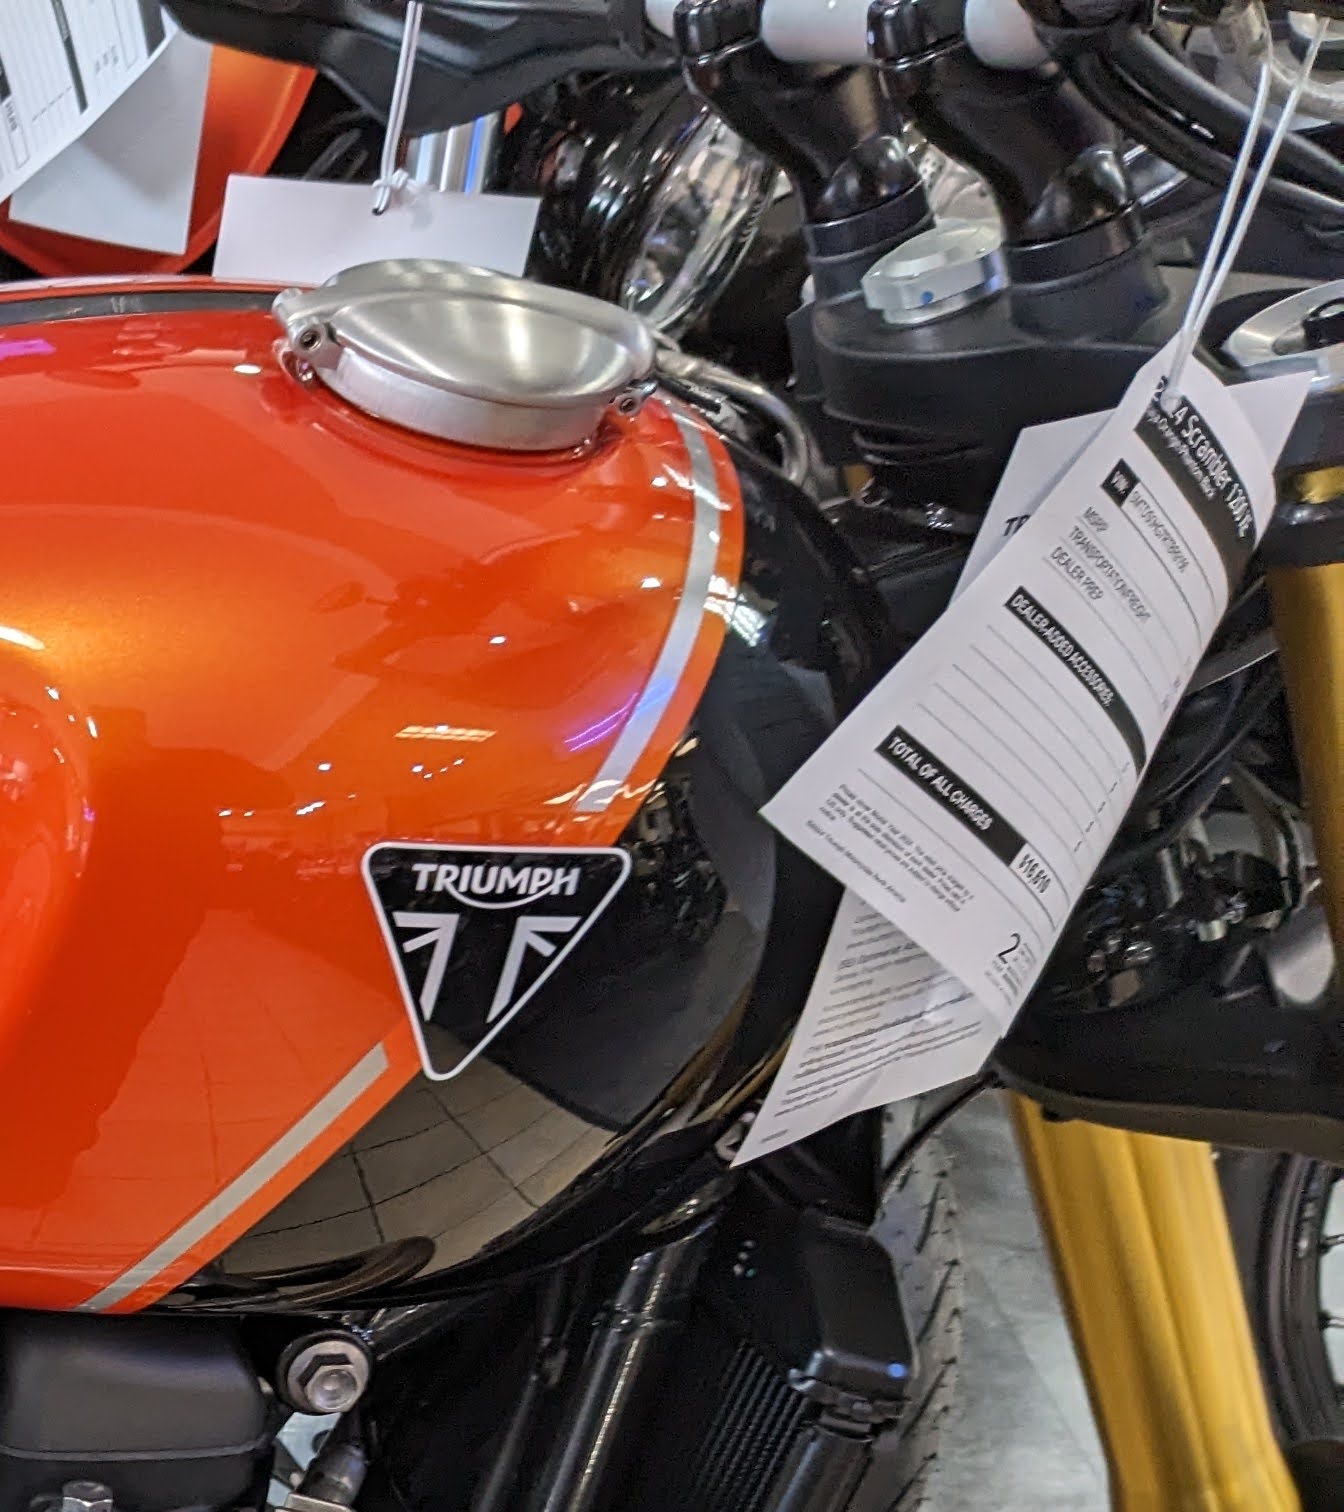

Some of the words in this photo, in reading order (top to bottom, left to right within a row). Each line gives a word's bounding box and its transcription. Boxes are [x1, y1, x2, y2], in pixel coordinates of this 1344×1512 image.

[1050, 546, 1085, 582] DEALER
[888, 736, 923, 771] TOTAL
[918, 763, 939, 780] OF
[930, 775, 955, 797] ALL
[949, 790, 993, 831] CHARGES
[413, 862, 581, 910] TRIUMPH
[998, 932, 1021, 965] 2
